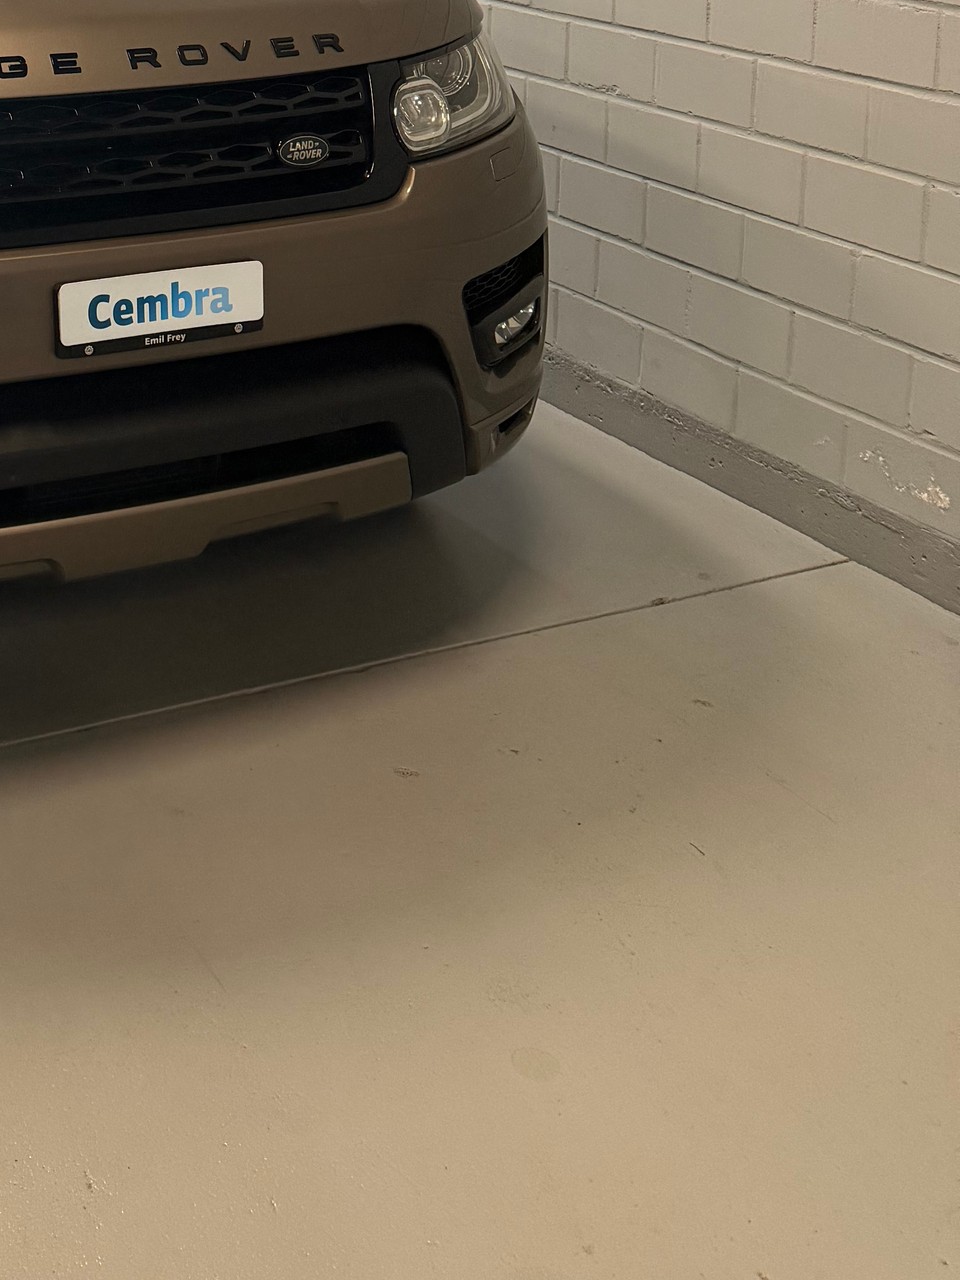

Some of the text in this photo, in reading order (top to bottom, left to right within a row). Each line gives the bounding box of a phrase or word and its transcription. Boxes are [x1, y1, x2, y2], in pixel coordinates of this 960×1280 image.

[126, 33, 344, 70] ROVER
[289, 140, 314, 152] LAND
[292, 148, 322, 161] ROVER
[88, 281, 233, 329] Cembra
[144, 333, 186, 346] Emil Frey
